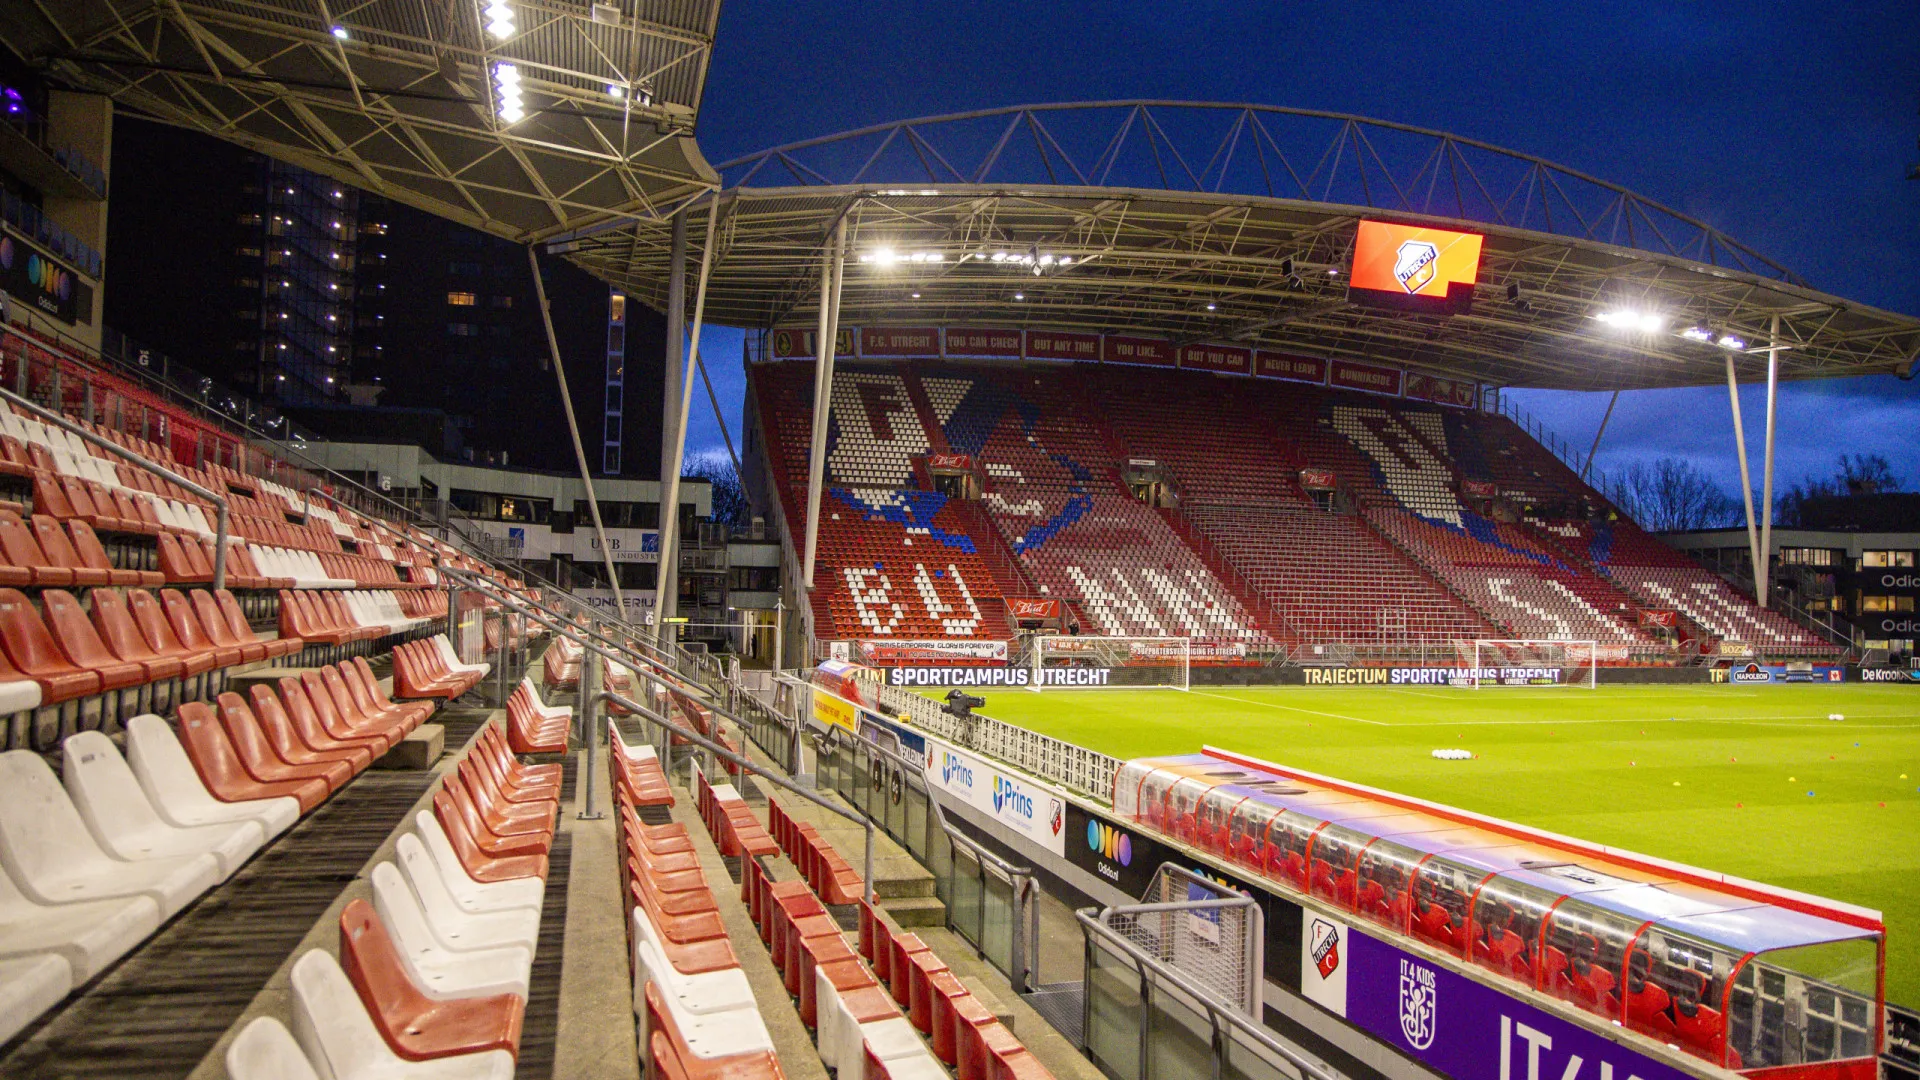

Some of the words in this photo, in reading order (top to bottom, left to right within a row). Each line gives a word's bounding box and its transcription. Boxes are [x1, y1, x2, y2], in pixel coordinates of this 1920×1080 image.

[870, 336, 887, 348] F.C.
[890, 335, 931, 348] UTRECHT
[947, 336, 967, 348] YOU
[969, 336, 987, 349] CAN
[989, 337, 1020, 350] CHECK
[1054, 340, 1073, 352] ANY
[1074, 341, 1095, 354] TIME
[1116, 343, 1133, 356] YOU
[1136, 345, 1164, 359] LIKE...
[1187, 350, 1205, 363] BUT
[1207, 352, 1224, 365] YOU
[1226, 354, 1243, 367] CAN
[1265, 358, 1290, 372] NEVER
[1292, 361, 1317, 376] LEAVE
[1339, 367, 1392, 387] BUNNIKSIDE
[591, 538, 620, 549] UB
[586, 597, 657, 608] JONERIU
[1019, 602, 1045, 614] Bud
[1137, 647, 1206, 655] SUPPORTERSVEREIGING
[1207, 647, 1215, 655] FC
[1216, 647, 1240, 655] UTRECHT
[892, 668, 1028, 685] SPORTCAMPUS
[1034, 668, 1111, 685] UTRECHT
[1303, 668, 1387, 684] TRAIECTUM
[1862, 668, 1875, 681] De
[951, 755, 973, 788] Prins
[1004, 780, 1033, 819] Prins
[1317, 925, 1323, 939] F
[1313, 928, 1339, 964] UTRECHT
[1325, 954, 1333, 969] C
[1400, 958, 1409, 976] IT
[1409, 963, 1415, 979] 4
[1416, 965, 1437, 990] KIDS
